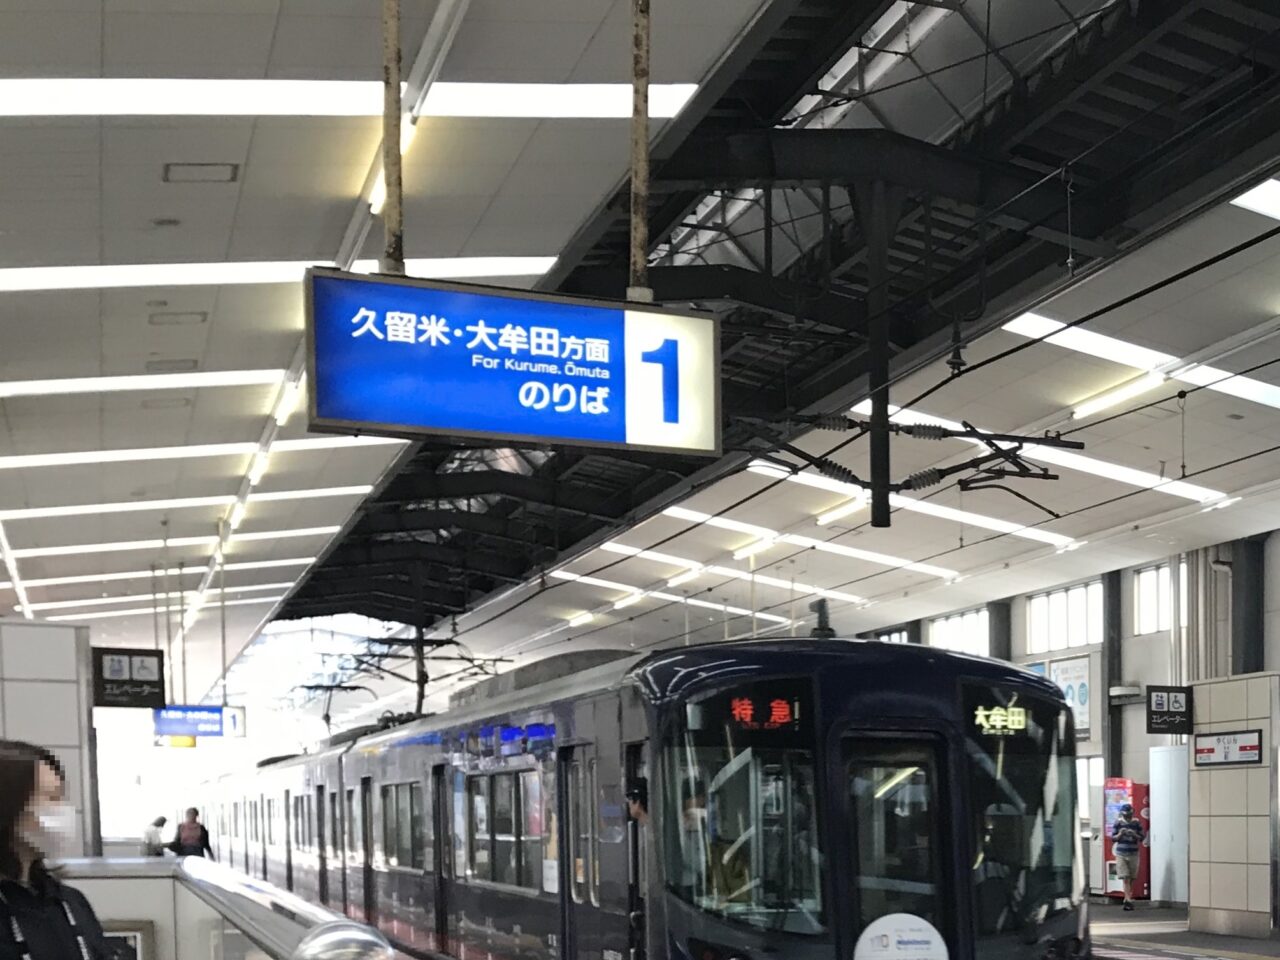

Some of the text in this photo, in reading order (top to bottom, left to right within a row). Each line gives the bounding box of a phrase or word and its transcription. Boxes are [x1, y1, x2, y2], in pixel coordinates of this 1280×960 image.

[351, 307, 609, 363] 久留米・大牟田方面
[472, 354, 500, 368] For
[641, 339, 679, 423] 1
[518, 381, 609, 415] のりば
[731, 697, 791, 722] 特急
[974, 705, 1026, 729] 大牟田
